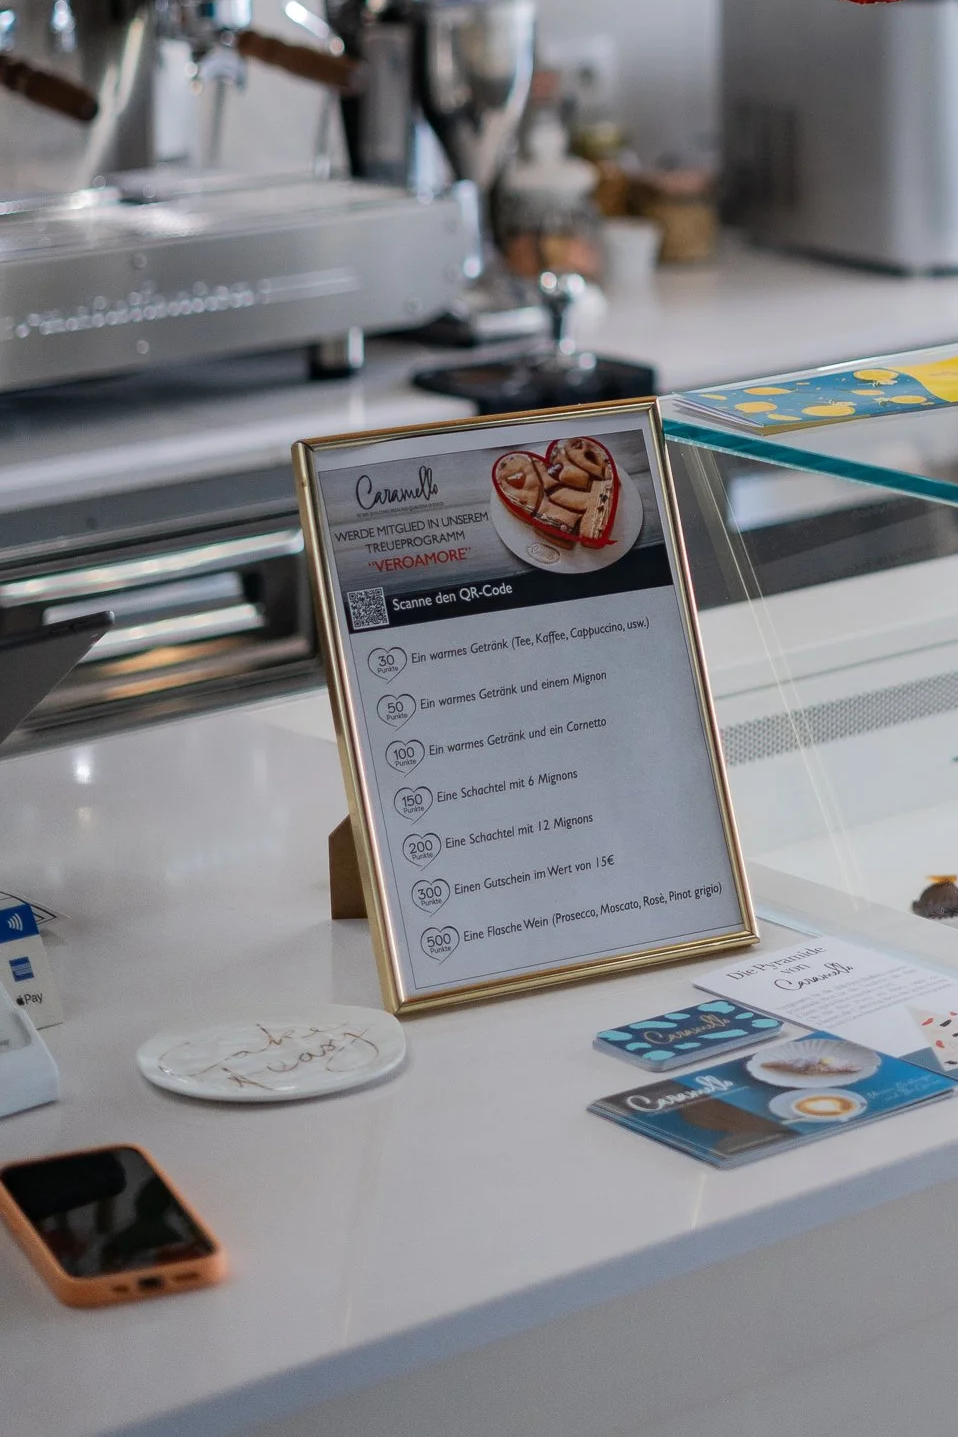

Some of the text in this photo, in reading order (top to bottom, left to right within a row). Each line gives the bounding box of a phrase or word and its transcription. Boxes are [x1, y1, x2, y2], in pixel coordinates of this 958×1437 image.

[356, 465, 439, 510] Caramello
[334, 511, 489, 542] WERDE MITGLIED IN UNSEREM
[365, 530, 466, 554] TREUEPROGRAMM
[392, 582, 513, 611] Scanne den QR-Code
[411, 616, 650, 664] Ein warmes Getränk (Tee, Kaffee, Cappuccino, usw.)
[378, 654, 395, 667] 30
[377, 665, 399, 674] Punkte
[419, 669, 607, 710] Ein warmes Getränk und einem Mignon
[387, 701, 404, 714] 50
[386, 712, 408, 721] Punkte
[429, 717, 607, 756] Ein warmes Getränk und ein Cornetto
[393, 746, 415, 760] 100
[395, 758, 417, 768] Punkte
[437, 769, 578, 803] Eine Schachtel mit 6 Mignons
[402, 793, 423, 807] 150
[403, 805, 425, 815] Punkte
[445, 814, 594, 849] Eine Schachtel mit 12 Mignons
[408, 839, 433, 854] 200
[412, 851, 433, 861] Punkte
[454, 853, 615, 896] Einen Gutschein im Wert von 15€
[417, 885, 442, 900] 300
[420, 897, 443, 907] Punkte
[463, 929, 485, 943] Eine
[486, 921, 523, 939] Flasche
[523, 916, 549, 931] Wein
[552, 908, 599, 928] (Prosecco,
[600, 898, 642, 916] Moscato,
[669, 887, 692, 902] Pinot
[694, 881, 722, 902] grigio)
[426, 932, 452, 948] 500
[430, 944, 452, 955] Punkte
[726, 945, 826, 981] Die Pyramide
[779, 962, 812, 976] von
[774, 961, 854, 991] Caramello
[24, 993, 43, 1004] Pay
[643, 1012, 731, 1045] Caramello
[626, 1074, 735, 1113] Caramello
